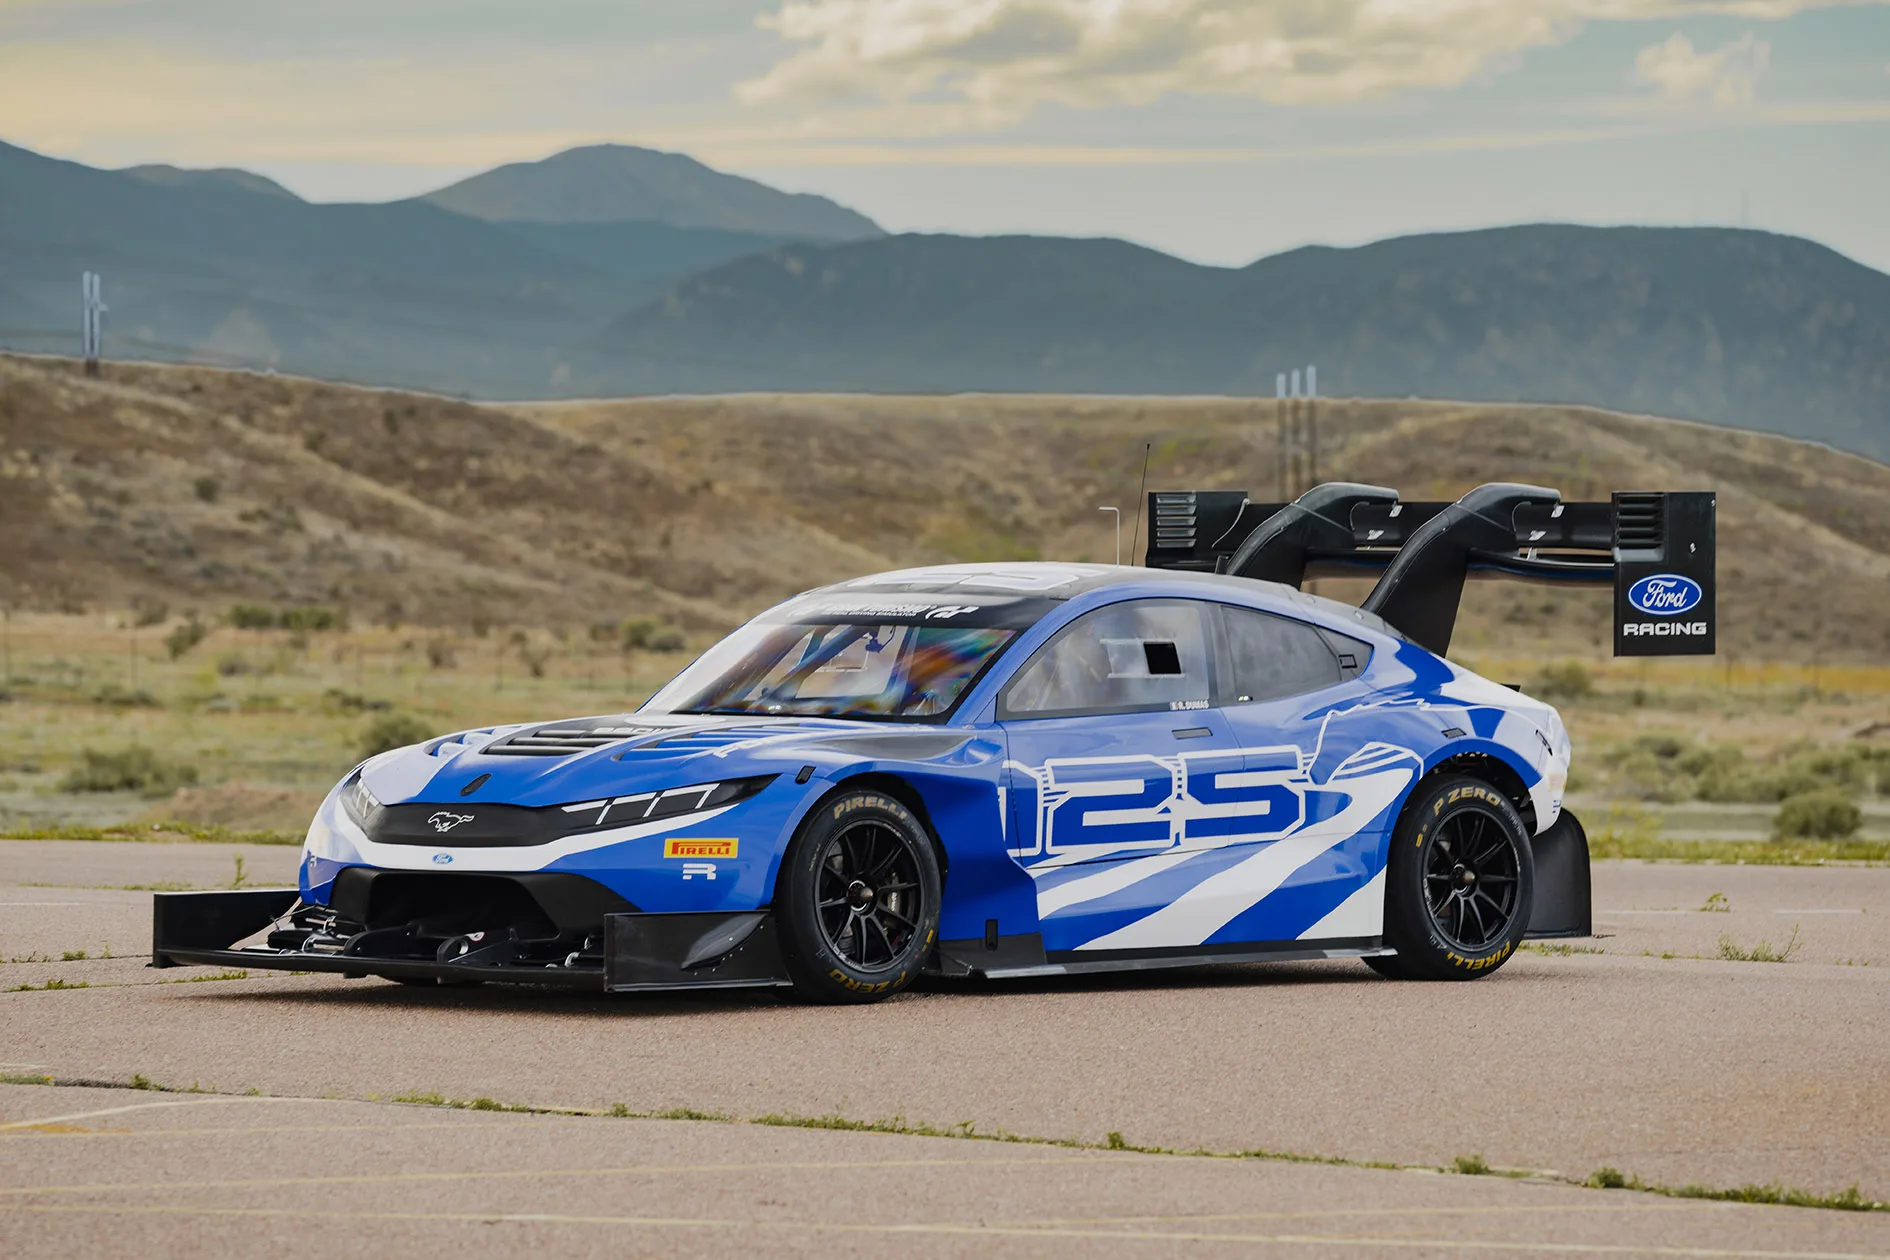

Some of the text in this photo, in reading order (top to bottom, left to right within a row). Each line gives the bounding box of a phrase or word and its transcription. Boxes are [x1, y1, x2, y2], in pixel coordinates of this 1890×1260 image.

[1642, 579, 1688, 608] Ford
[1623, 622, 1708, 636] RACING
[833, 796, 908, 820] PIRELLI
[1433, 786, 1501, 817] P ZERO
[671, 841, 732, 855] PIRELLI
[1447, 940, 1511, 970] PIRELLI
[828, 968, 890, 994] ZERO
